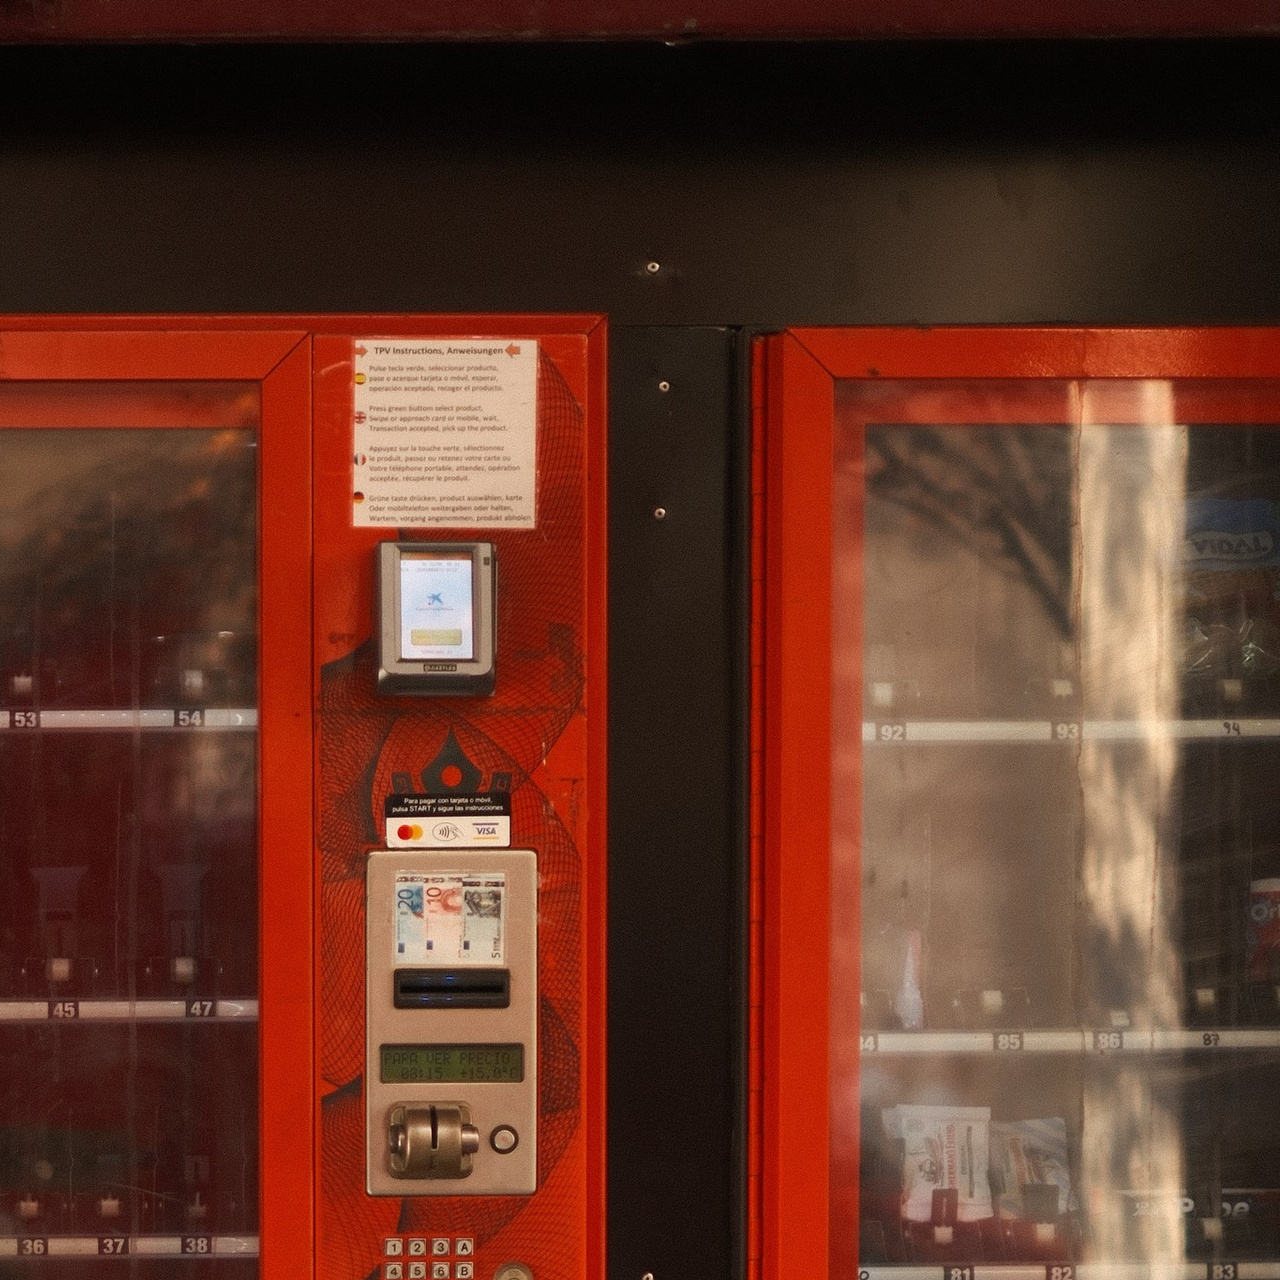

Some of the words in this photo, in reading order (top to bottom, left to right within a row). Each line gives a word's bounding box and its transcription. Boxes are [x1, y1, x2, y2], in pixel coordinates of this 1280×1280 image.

[392, 346, 445, 355] Instructions,
[446, 346, 504, 355] Anweisungen
[368, 415, 390, 423] Swipe
[1194, 536, 1268, 555] VIDAL
[15, 712, 37, 727] 53
[179, 711, 202, 726] 54
[881, 725, 903, 740] 92
[1056, 724, 1079, 739] 93
[1223, 721, 1240, 735] 94
[450, 797, 469, 805] tarjeta
[392, 805, 408, 813] pulsa
[476, 827, 496, 835] VISA
[53, 1003, 75, 1018] 45
[190, 1002, 212, 1017] 47
[998, 1034, 1020, 1050] 85
[1098, 1033, 1120, 1049] 86
[1203, 1032, 1219, 1046] 87
[384, 1052, 418, 1065] PARA
[426, 1052, 451, 1064] VER
[459, 1052, 510, 1064] PRECIO
[22, 1240, 44, 1255] 36
[103, 1239, 124, 1254] 37
[185, 1239, 207, 1253] 38
[391, 1243, 397, 1252] 1
[414, 1243, 421, 1252] 2
[437, 1243, 445, 1252] 3
[460, 1243, 468, 1252] A
[390, 1267, 397, 1276] 4
[414, 1267, 421, 1276] 5
[437, 1267, 445, 1276] 6
[460, 1267, 468, 1276] B
[1213, 1265, 1235, 1280] 83
